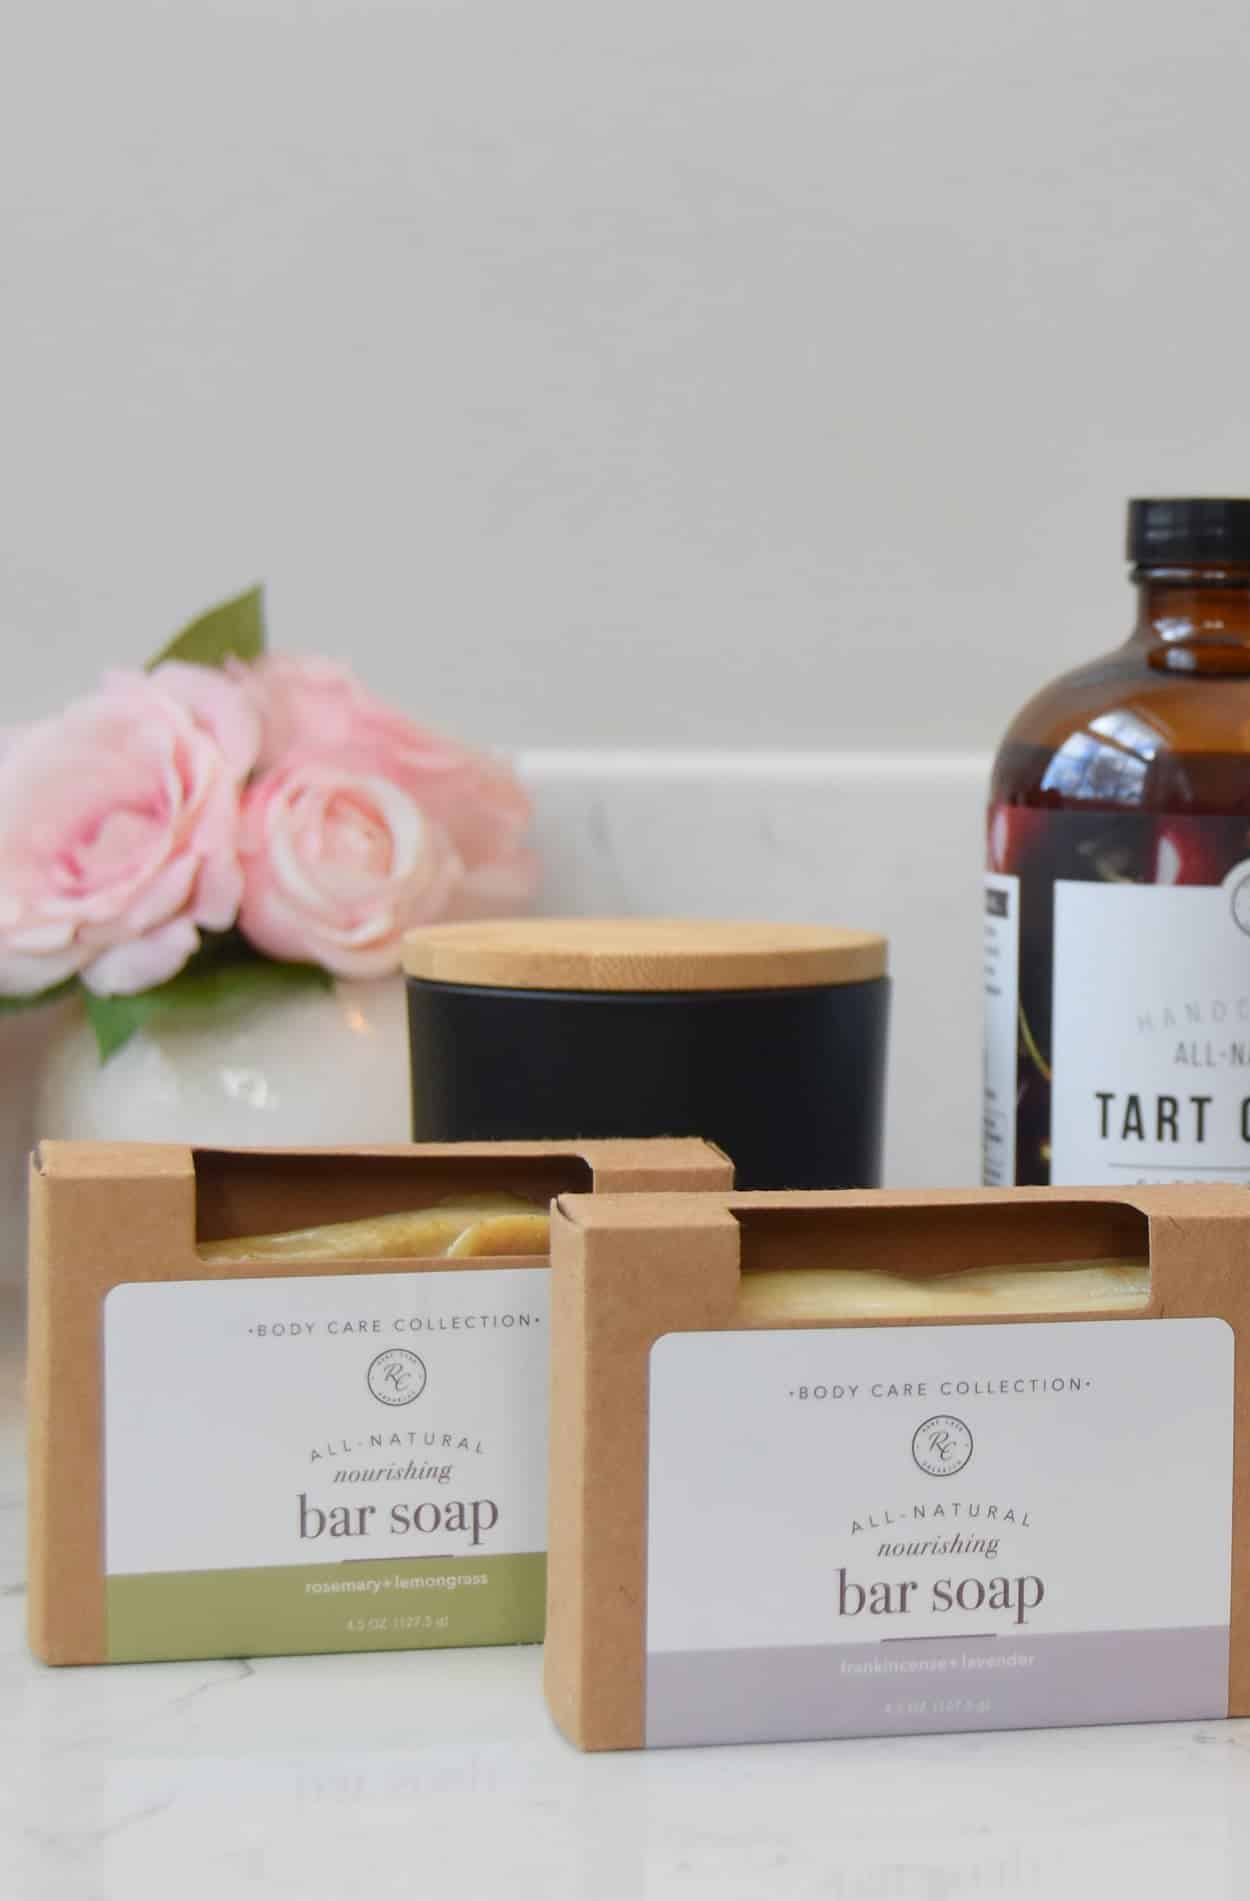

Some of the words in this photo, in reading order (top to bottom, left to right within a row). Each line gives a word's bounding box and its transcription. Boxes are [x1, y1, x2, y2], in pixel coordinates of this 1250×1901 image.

[1096, 1091, 1214, 1144] TART
[327, 1318, 382, 1335] CARE
[871, 1383, 928, 1399] CARE
[310, 1431, 485, 1463] ALL-NATURAL
[332, 1462, 453, 1485] nourishing
[296, 1493, 376, 1539] bar
[390, 1497, 500, 1547] soap
[850, 1502, 1032, 1535] ALL-NATURAL
[877, 1532, 1000, 1559] nourishing
[836, 1567, 919, 1618] bar
[931, 1573, 1046, 1625] soap
